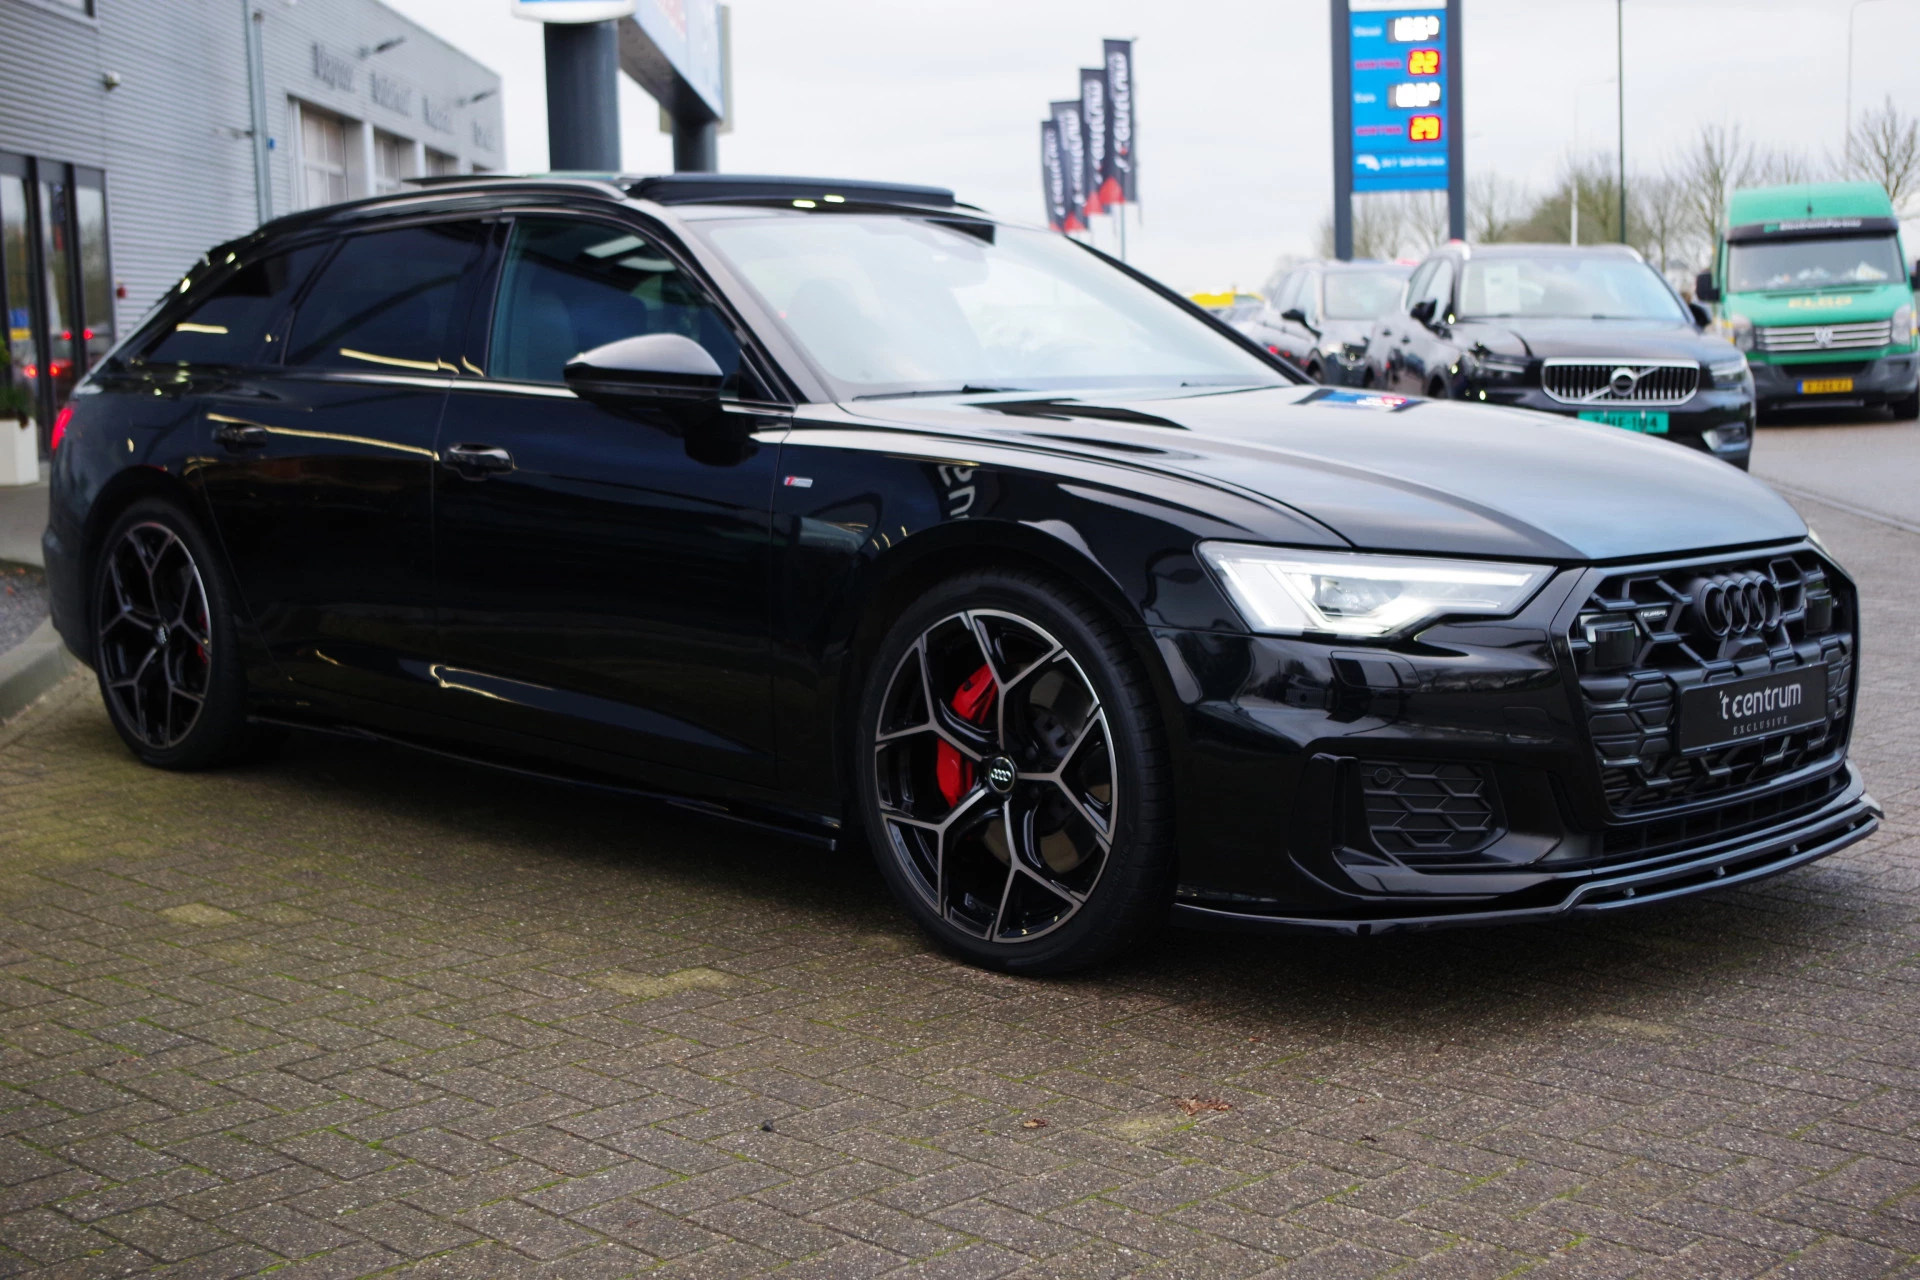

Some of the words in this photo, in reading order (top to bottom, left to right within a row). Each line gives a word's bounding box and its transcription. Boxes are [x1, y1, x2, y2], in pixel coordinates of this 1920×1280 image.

[1719, 690, 1730, 720] 't
[1732, 682, 1802, 719] centrum
[1732, 715, 1789, 736] EXCLUSIVE
